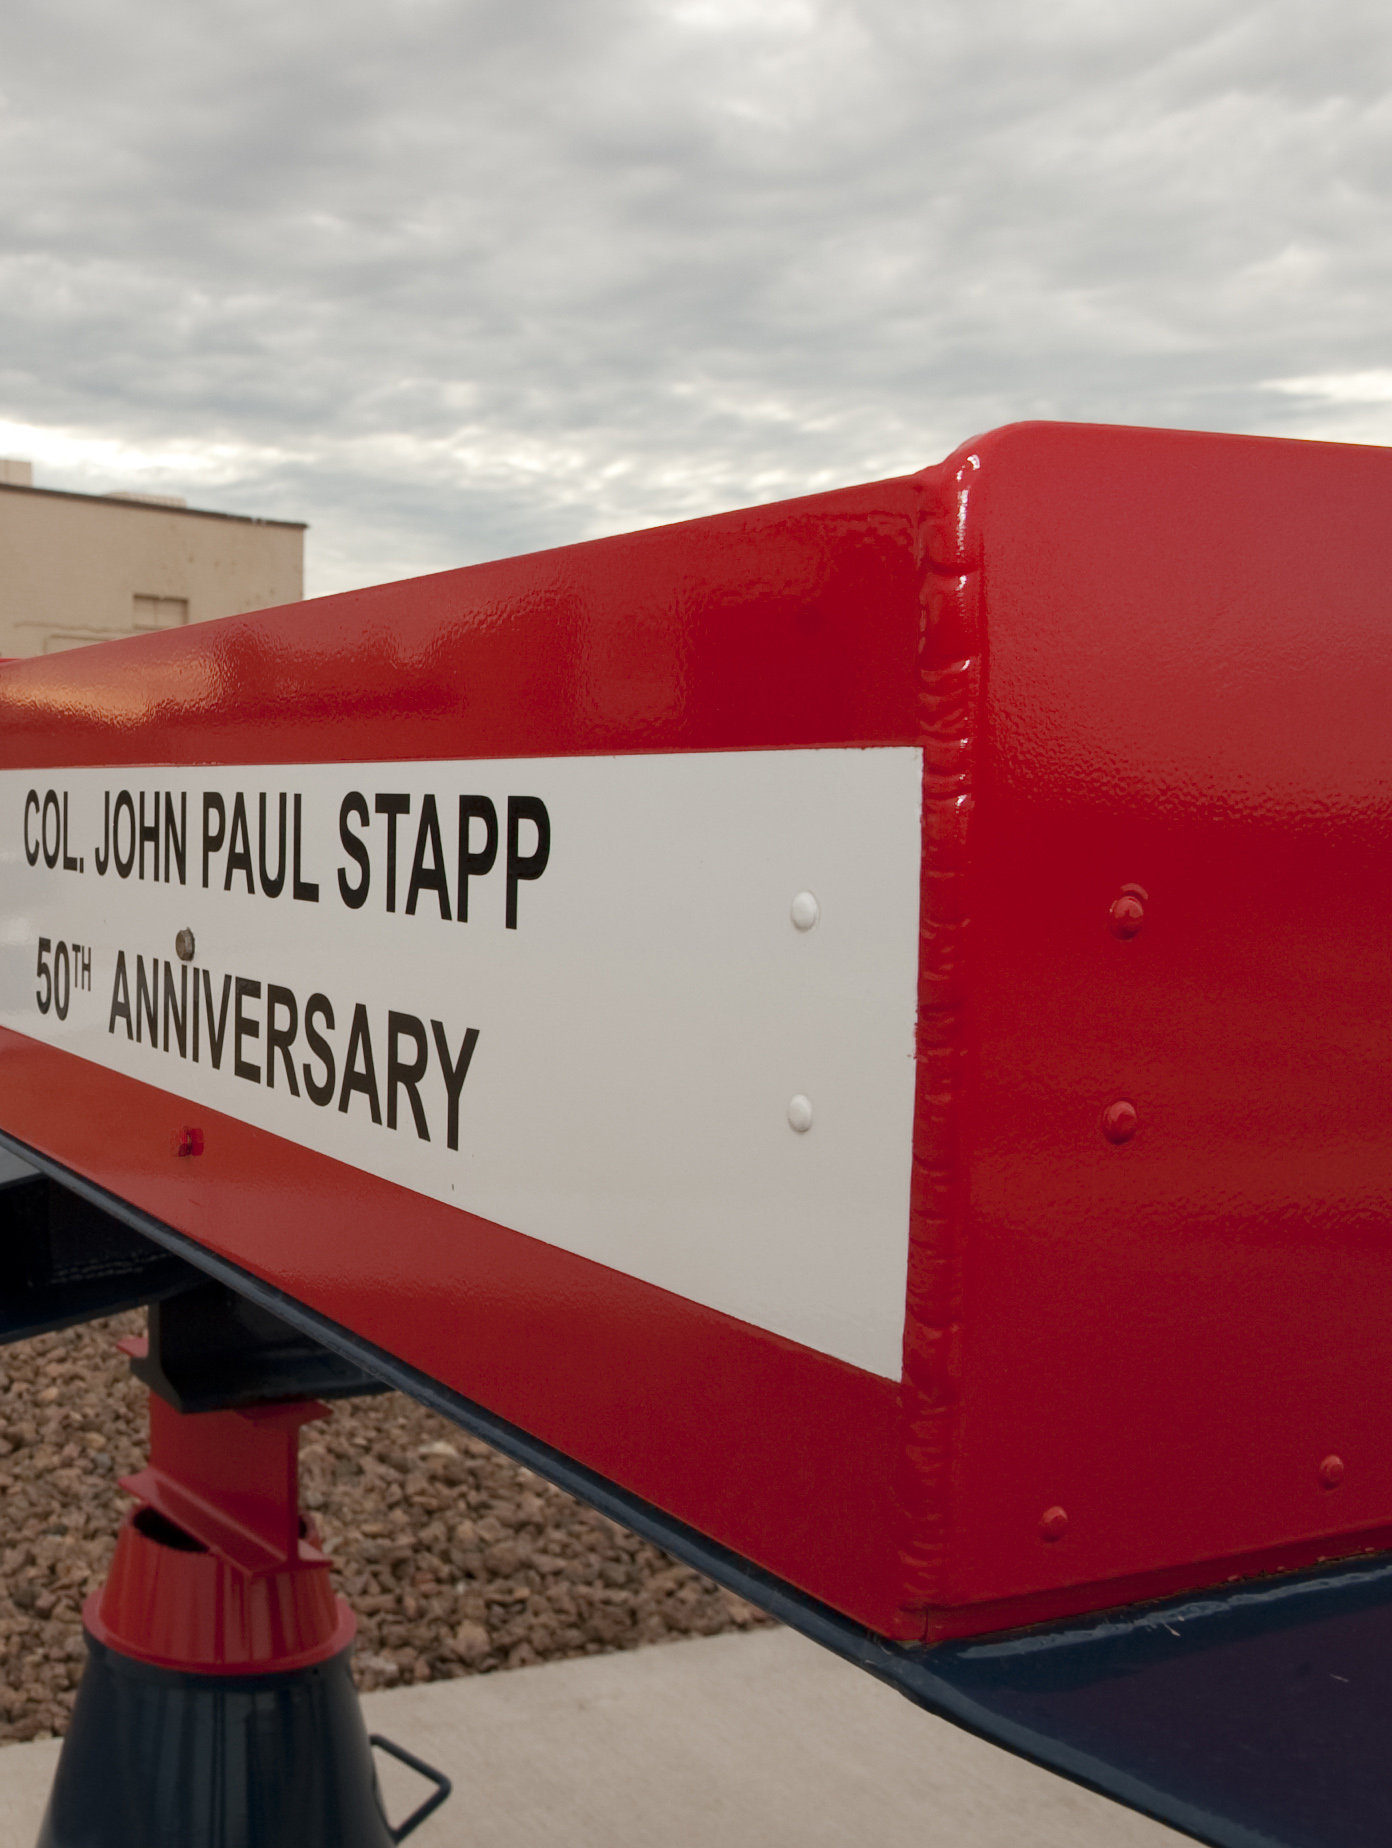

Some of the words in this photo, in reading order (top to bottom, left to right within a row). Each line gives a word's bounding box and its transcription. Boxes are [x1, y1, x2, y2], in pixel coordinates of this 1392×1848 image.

[23, 788, 85, 874] COL.
[94, 789, 187, 886] JOHN
[202, 790, 320, 903] PAUL
[337, 791, 552, 930] STAPP
[35, 936, 92, 1022] 50TH
[108, 949, 481, 1152] ANNIVERSARY
